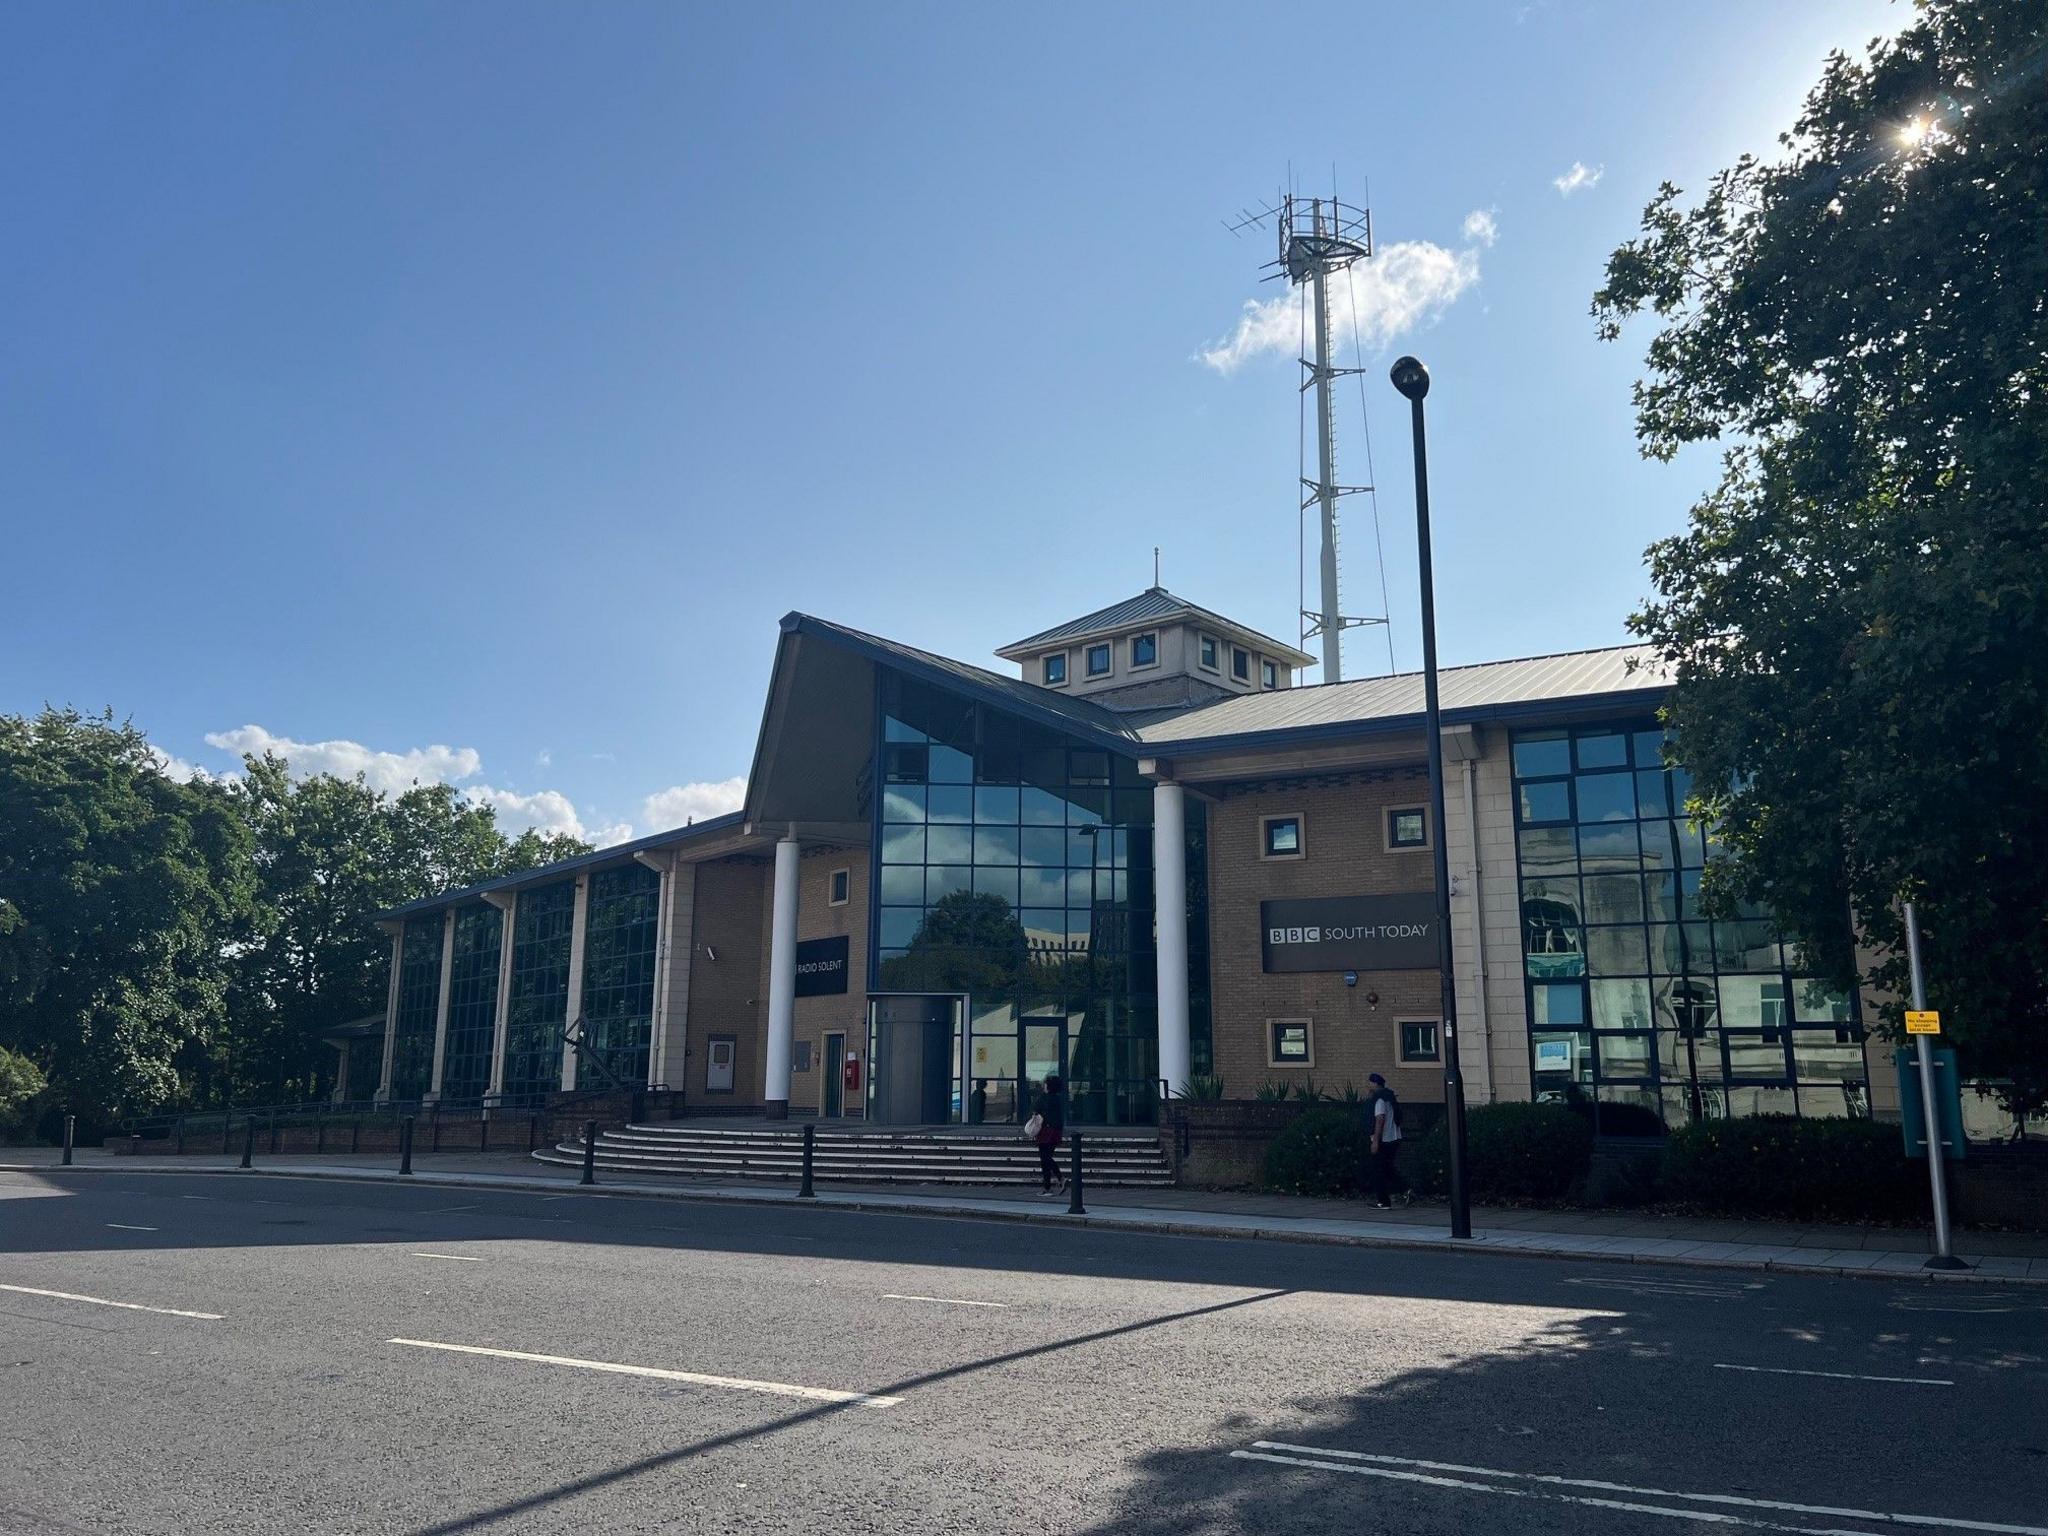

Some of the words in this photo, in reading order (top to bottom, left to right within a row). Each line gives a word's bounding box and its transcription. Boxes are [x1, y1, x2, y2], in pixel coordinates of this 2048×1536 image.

[1270, 926, 1321, 944] BBC
[1325, 926, 1376, 940] SOUTH
[1378, 924, 1429, 938] TODAY
[818, 960, 842, 971] SOLENT
